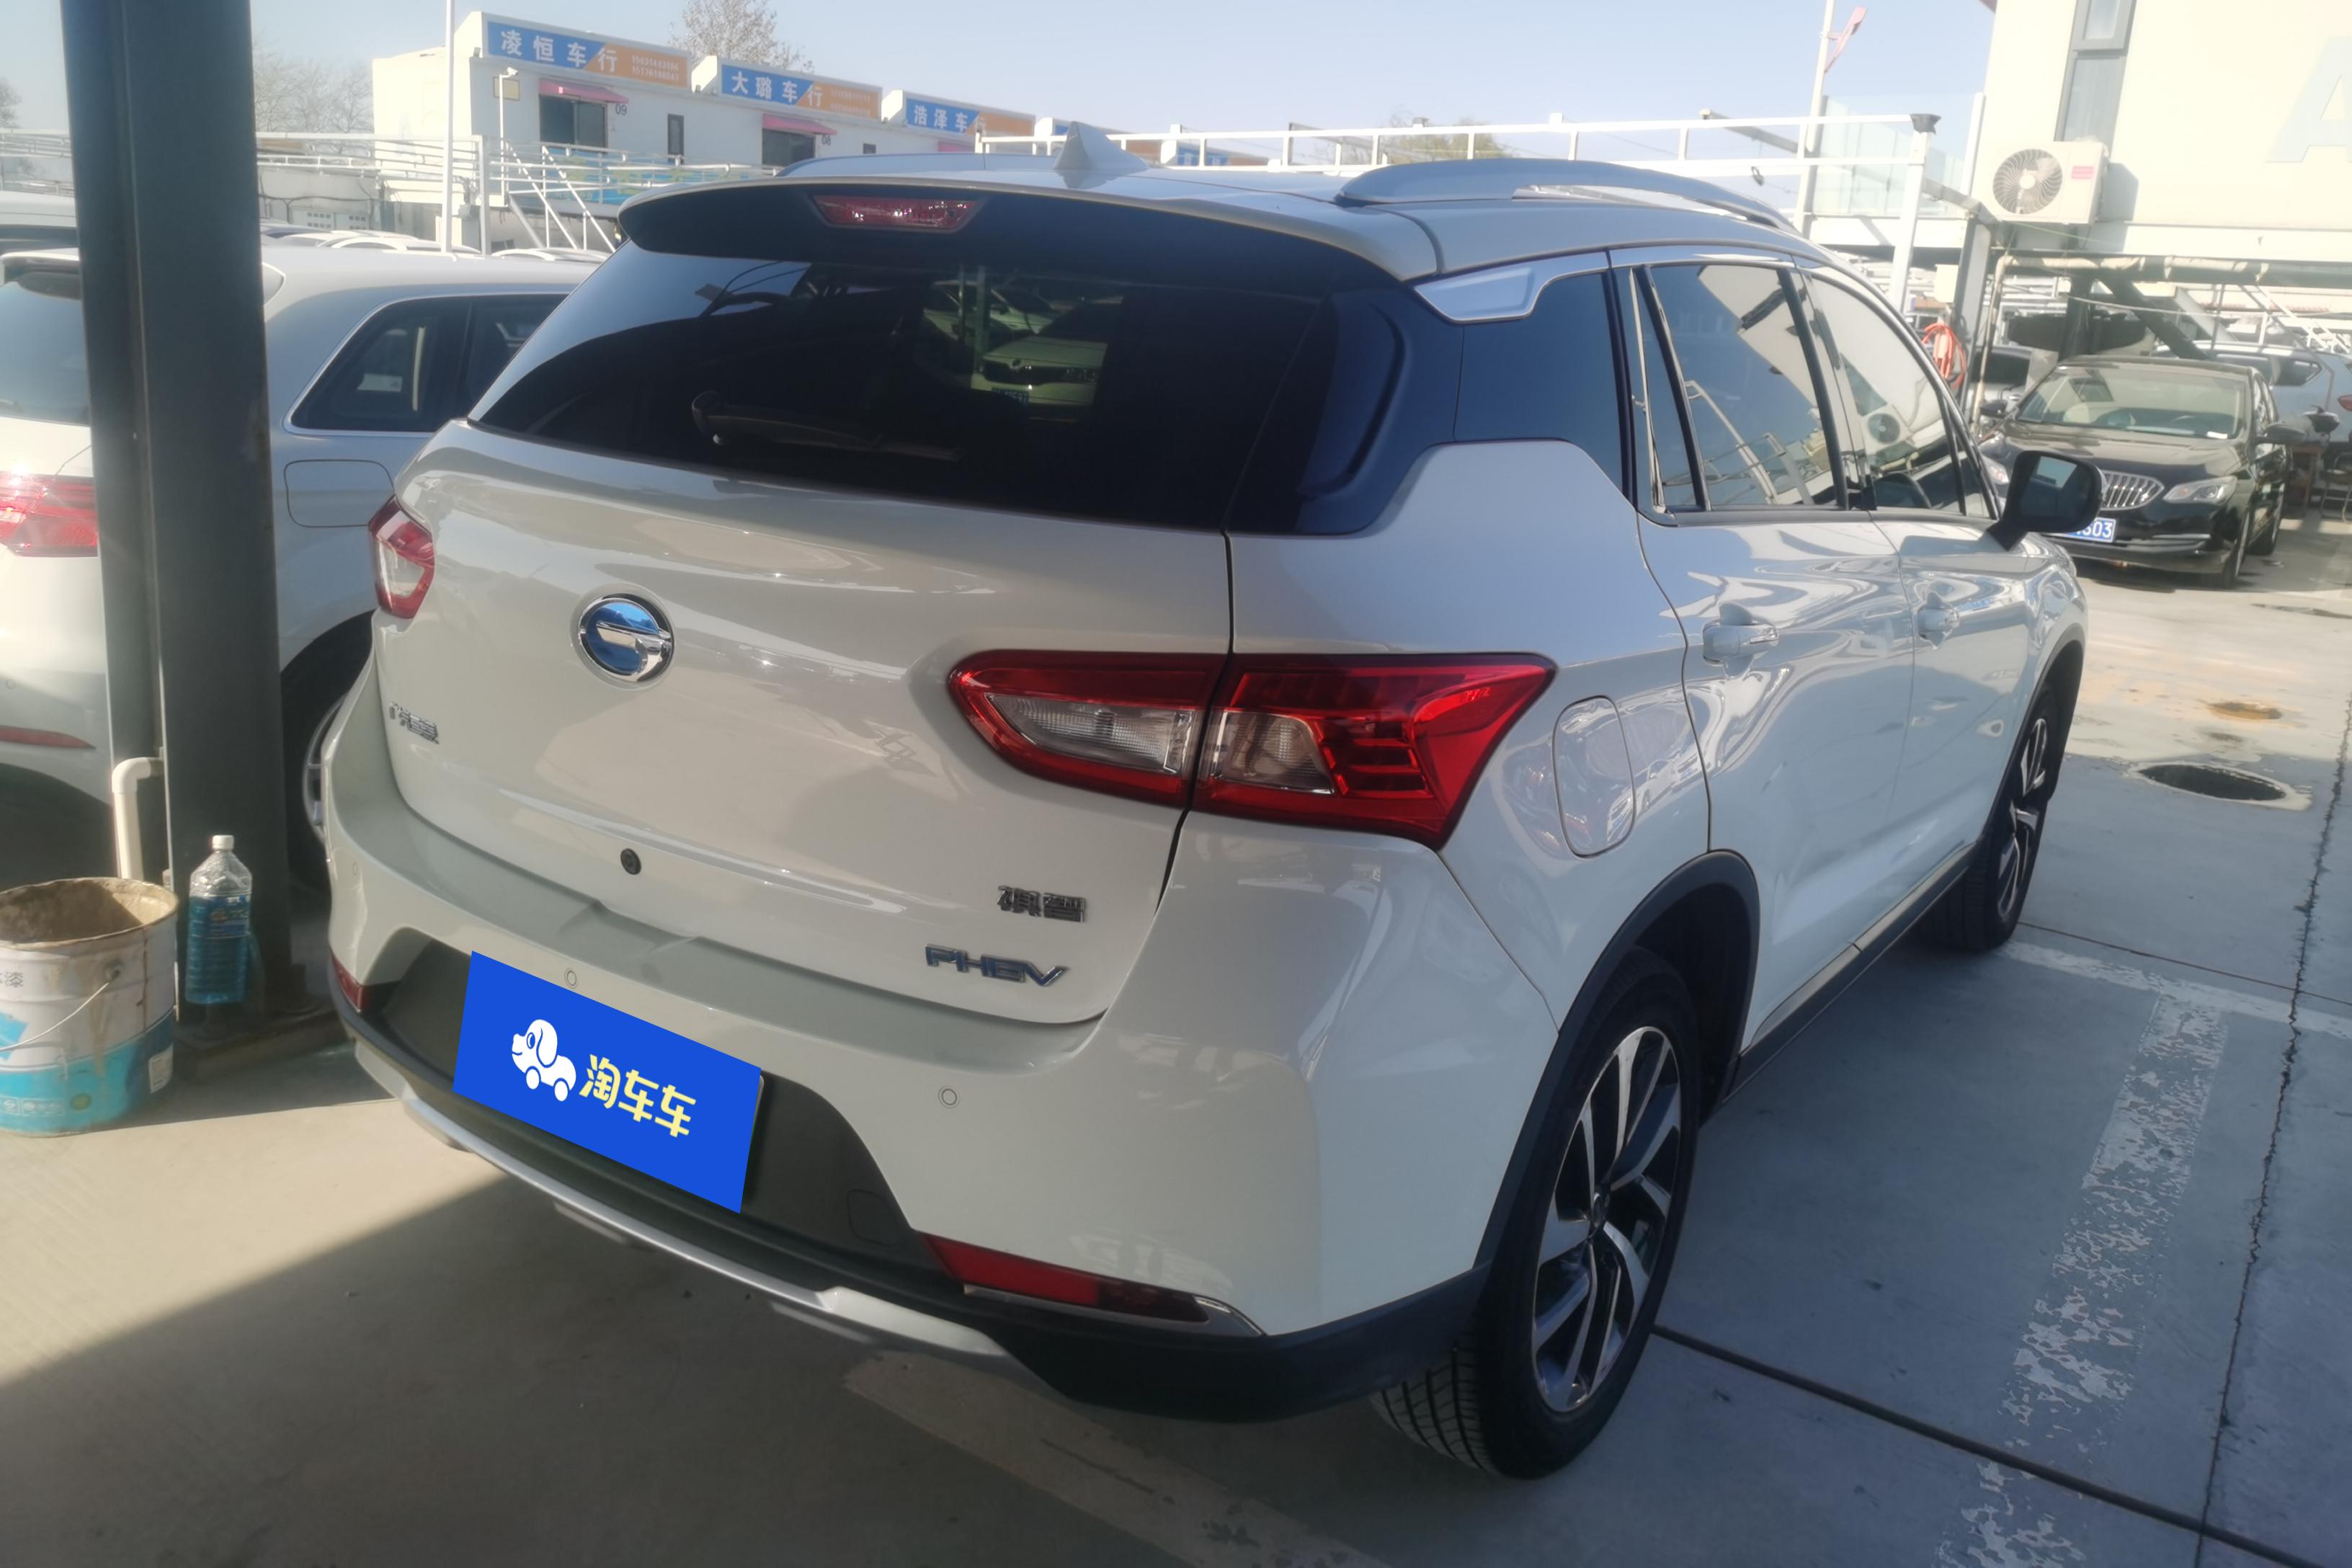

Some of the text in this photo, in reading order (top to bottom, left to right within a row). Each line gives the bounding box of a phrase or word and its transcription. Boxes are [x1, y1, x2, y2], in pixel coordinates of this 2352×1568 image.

[501, 30, 618, 72] 凌恒车行
[731, 71, 823, 107] 大璐车行
[615, 103, 627, 116] 09
[997, 886, 1087, 923] 祺智
[925, 943, 1070, 986] PHEV
